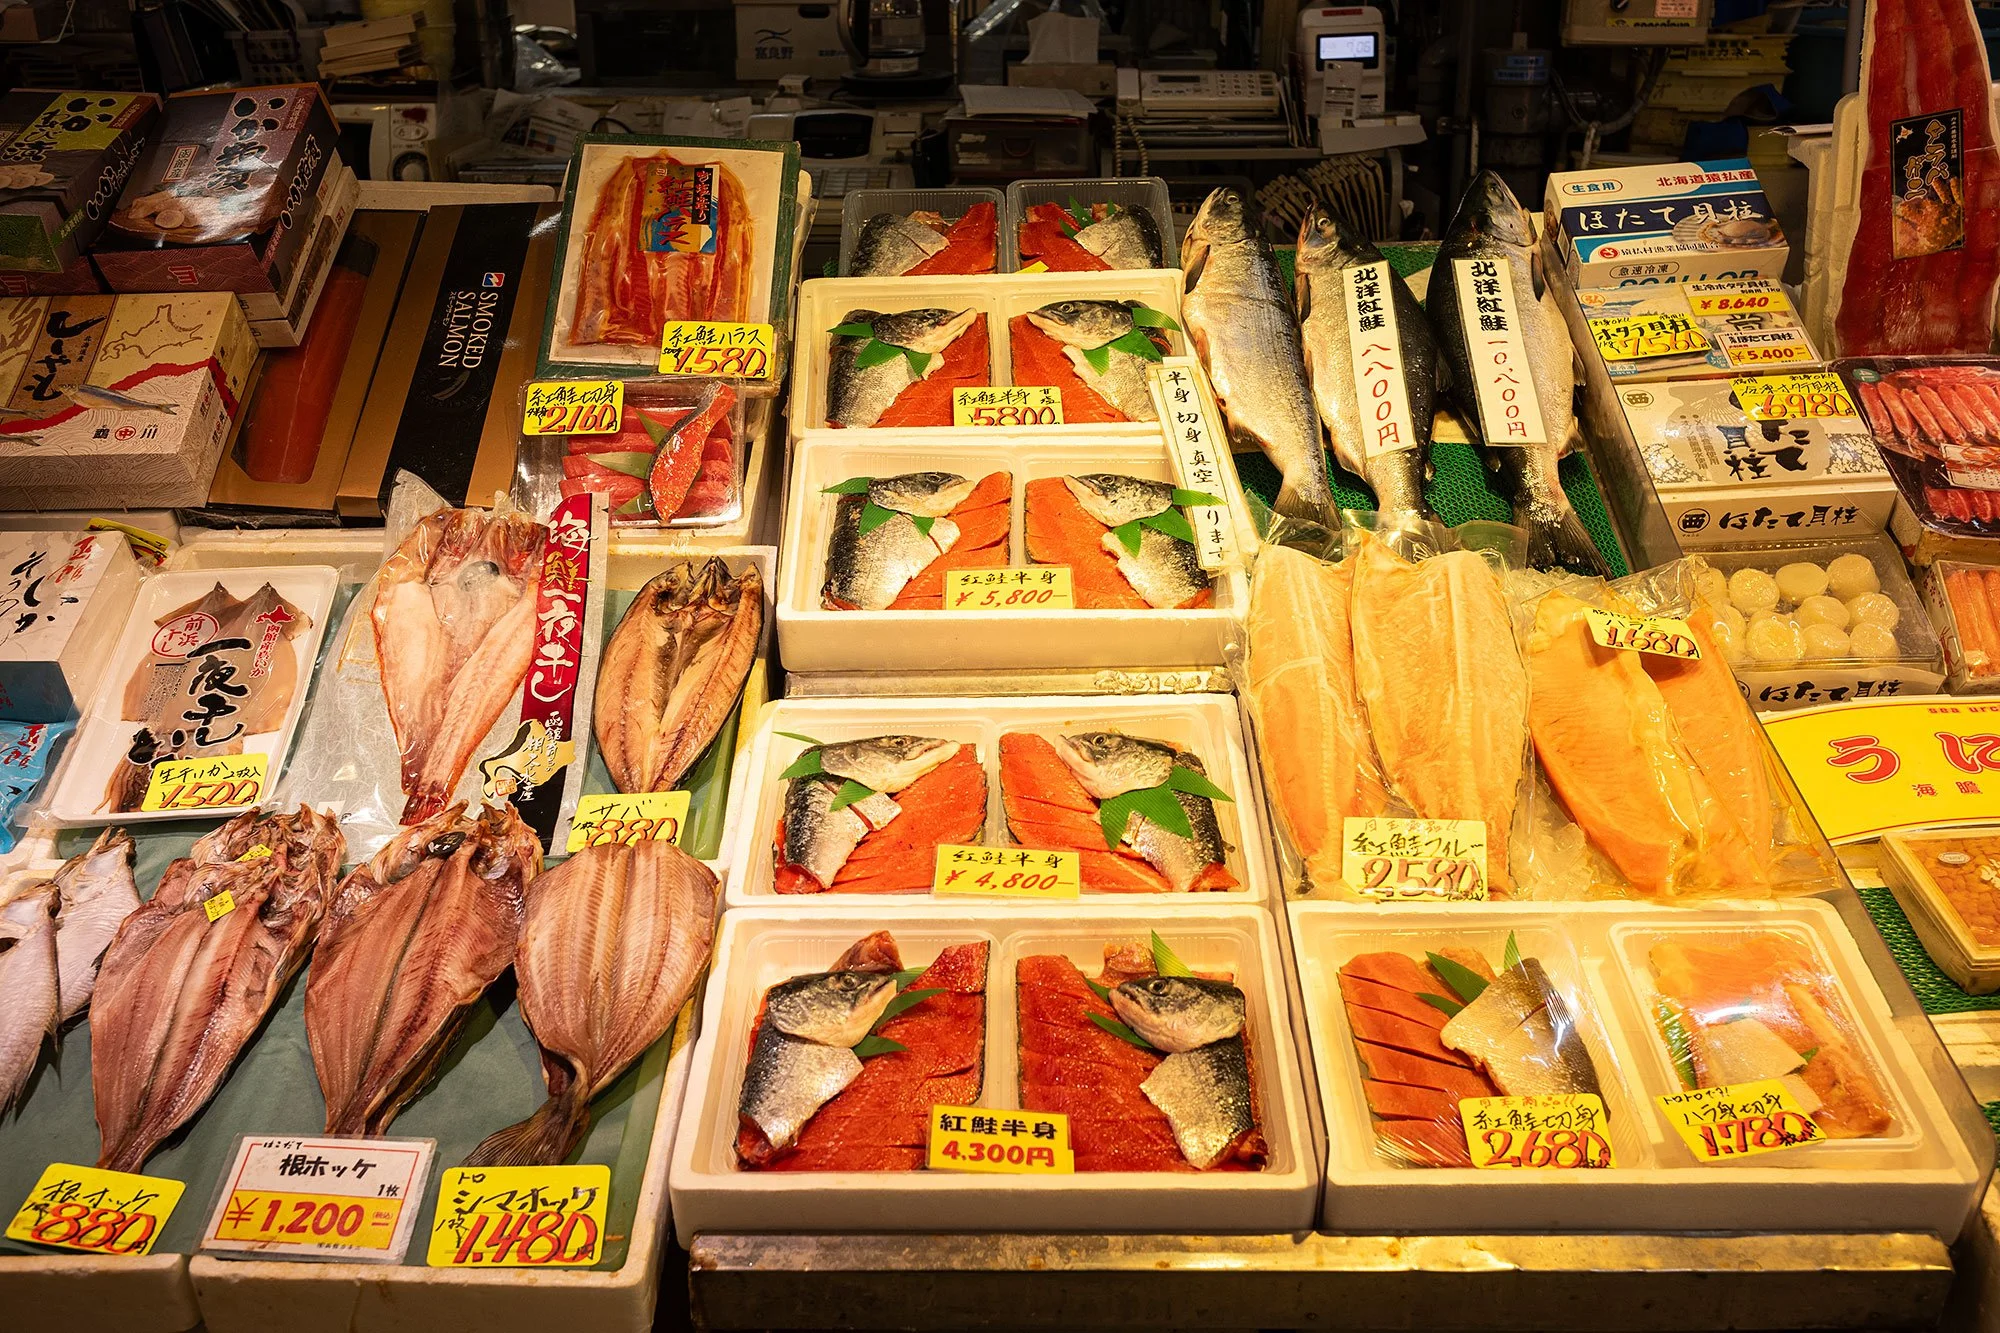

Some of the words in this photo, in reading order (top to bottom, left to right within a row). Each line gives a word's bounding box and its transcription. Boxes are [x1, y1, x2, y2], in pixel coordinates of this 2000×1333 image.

[1571, 182, 1617, 194] 生食用
[1655, 169, 1756, 187] 北海道猿払産
[1578, 199, 1765, 232] ほたて貝柱
[1354, 267, 1386, 333] 北洋紅鮭
[1470, 261, 1509, 332] 北洋紅鮭
[437, 291, 477, 368] SALMON
[461, 291, 499, 369] SMOKED
[669, 325, 766, 347] 紅鮭ハラス
[529, 382, 619, 406] 紅鮭切身
[958, 388, 1031, 406] 紅鮭半身
[1165, 370, 1190, 403] 半身
[1176, 411, 1202, 443] 切身
[1718, 504, 1861, 531] ほたて貝柱
[960, 571, 1057, 586] 紅鮭半身
[532, 510, 600, 703] 海鮮一夜干し
[186, 637, 253, 747] 一夜干し
[1827, 731, 2000, 784] うに
[589, 799, 652, 821] サバ
[952, 850, 1063, 869] 紅鮭半身
[939, 1113, 1058, 1140] 紅鮭半身
[1473, 1103, 1600, 1131] 紅鮭切身
[262, 1141, 304, 1150] はこだて
[941, 1139, 1056, 1168] 4.300円
[279, 1153, 377, 1180] 根ホッケ
[458, 1171, 487, 1186] トロ
[42, 1179, 161, 1213] 根ホッケ
[377, 1183, 401, 1197] 1枚
[260, 1199, 366, 1238] 1,200
